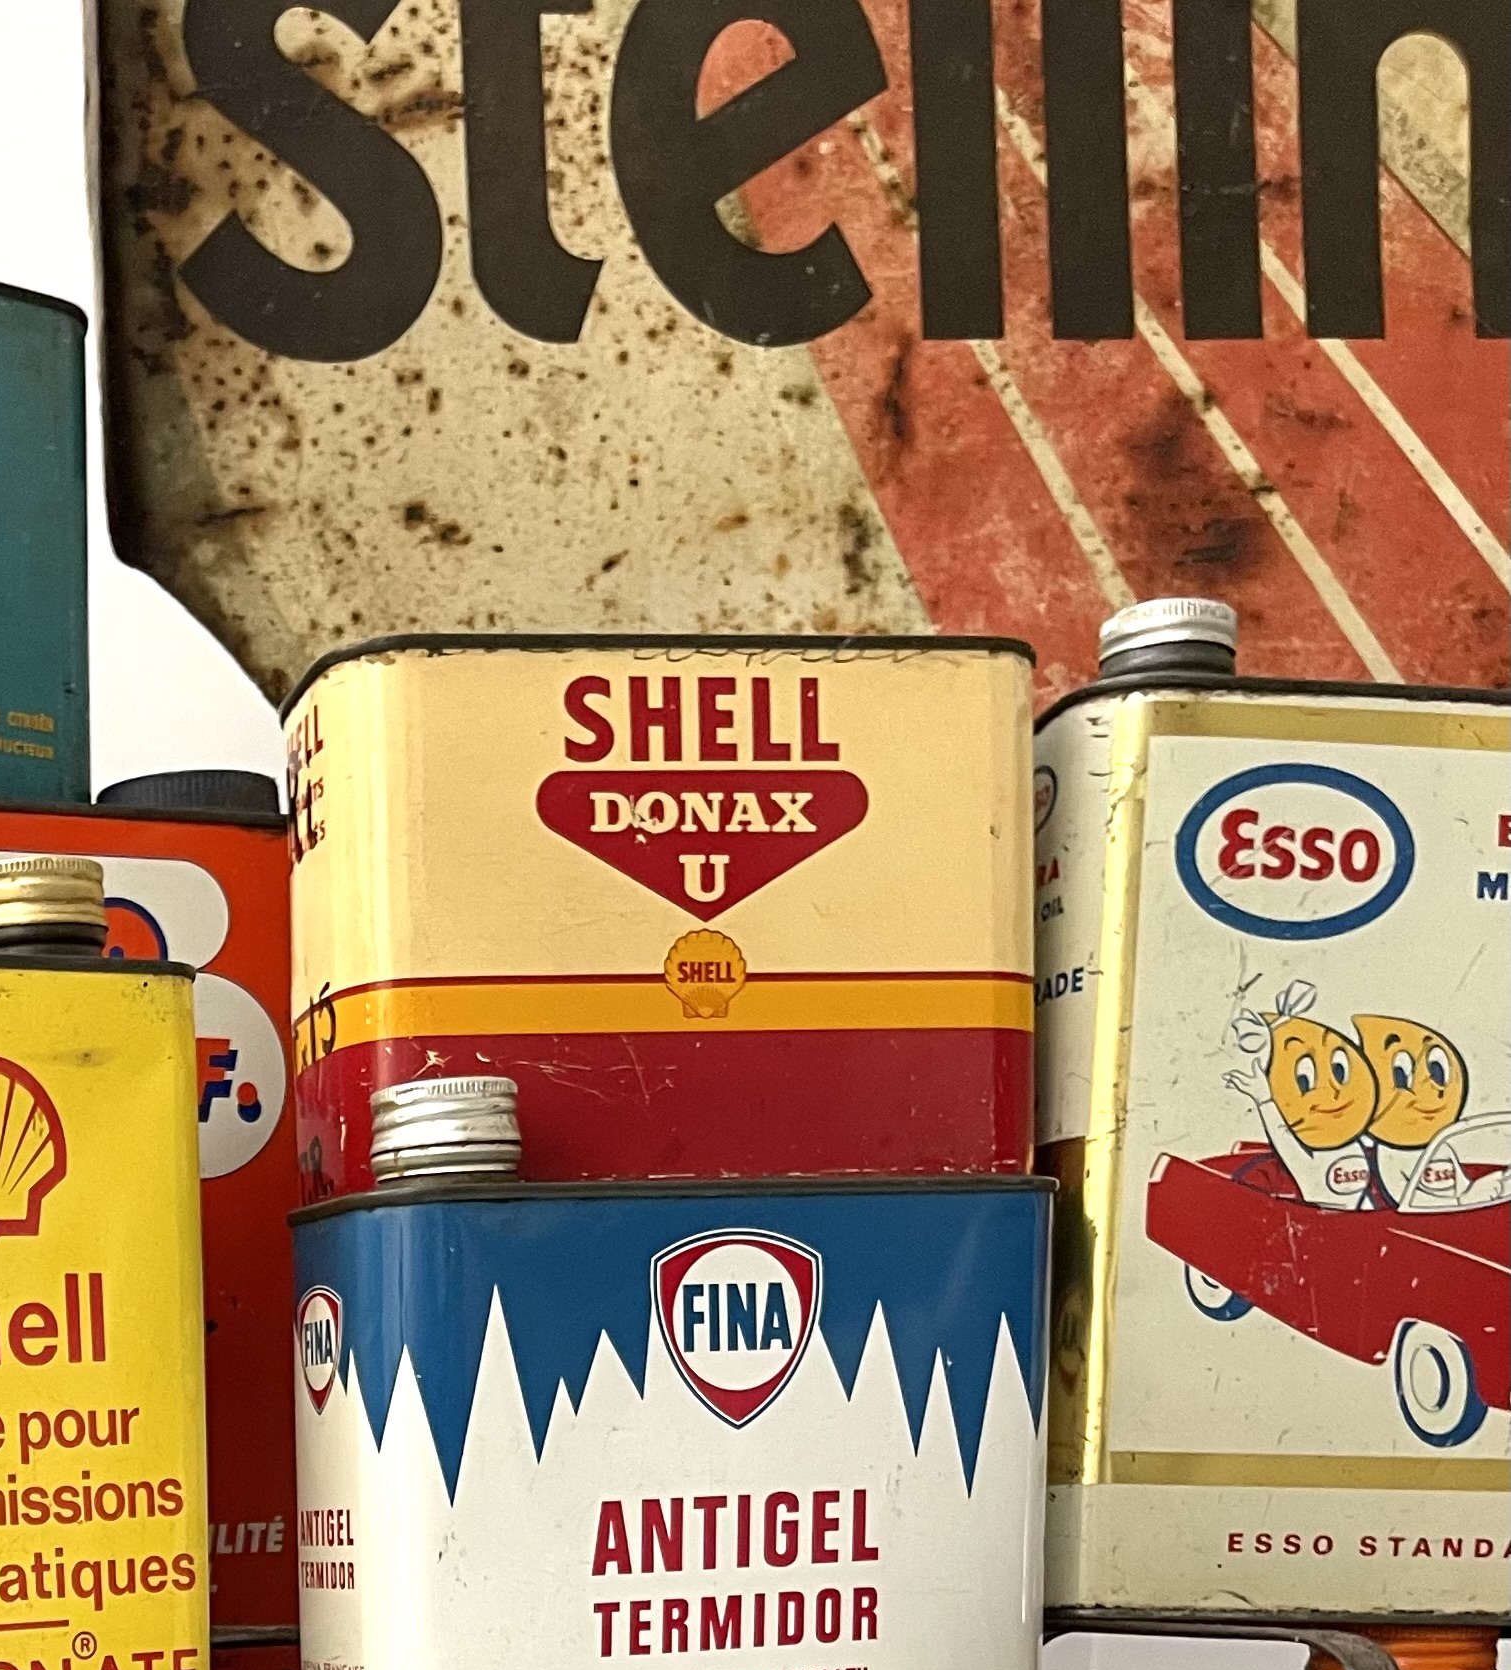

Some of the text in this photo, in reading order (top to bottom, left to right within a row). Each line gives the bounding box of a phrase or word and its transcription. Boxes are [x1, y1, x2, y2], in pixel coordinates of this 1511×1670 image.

[563, 675, 840, 763] SHELL
[589, 791, 817, 834] DONAX
[679, 854, 730, 903] U
[676, 960, 737, 985] SHELL
[682, 1280, 792, 1354] FINA
[304, 1319, 334, 1368] FINA
[20, 1404, 139, 1463] pour
[300, 1509, 355, 1547] ANTIGEL
[591, 1489, 879, 1576] ANTIGEL
[1227, 1533, 1334, 1555] ESSO
[301, 1561, 355, 1590] TERMIDOR
[593, 1587, 878, 1658] TERMIDOR
